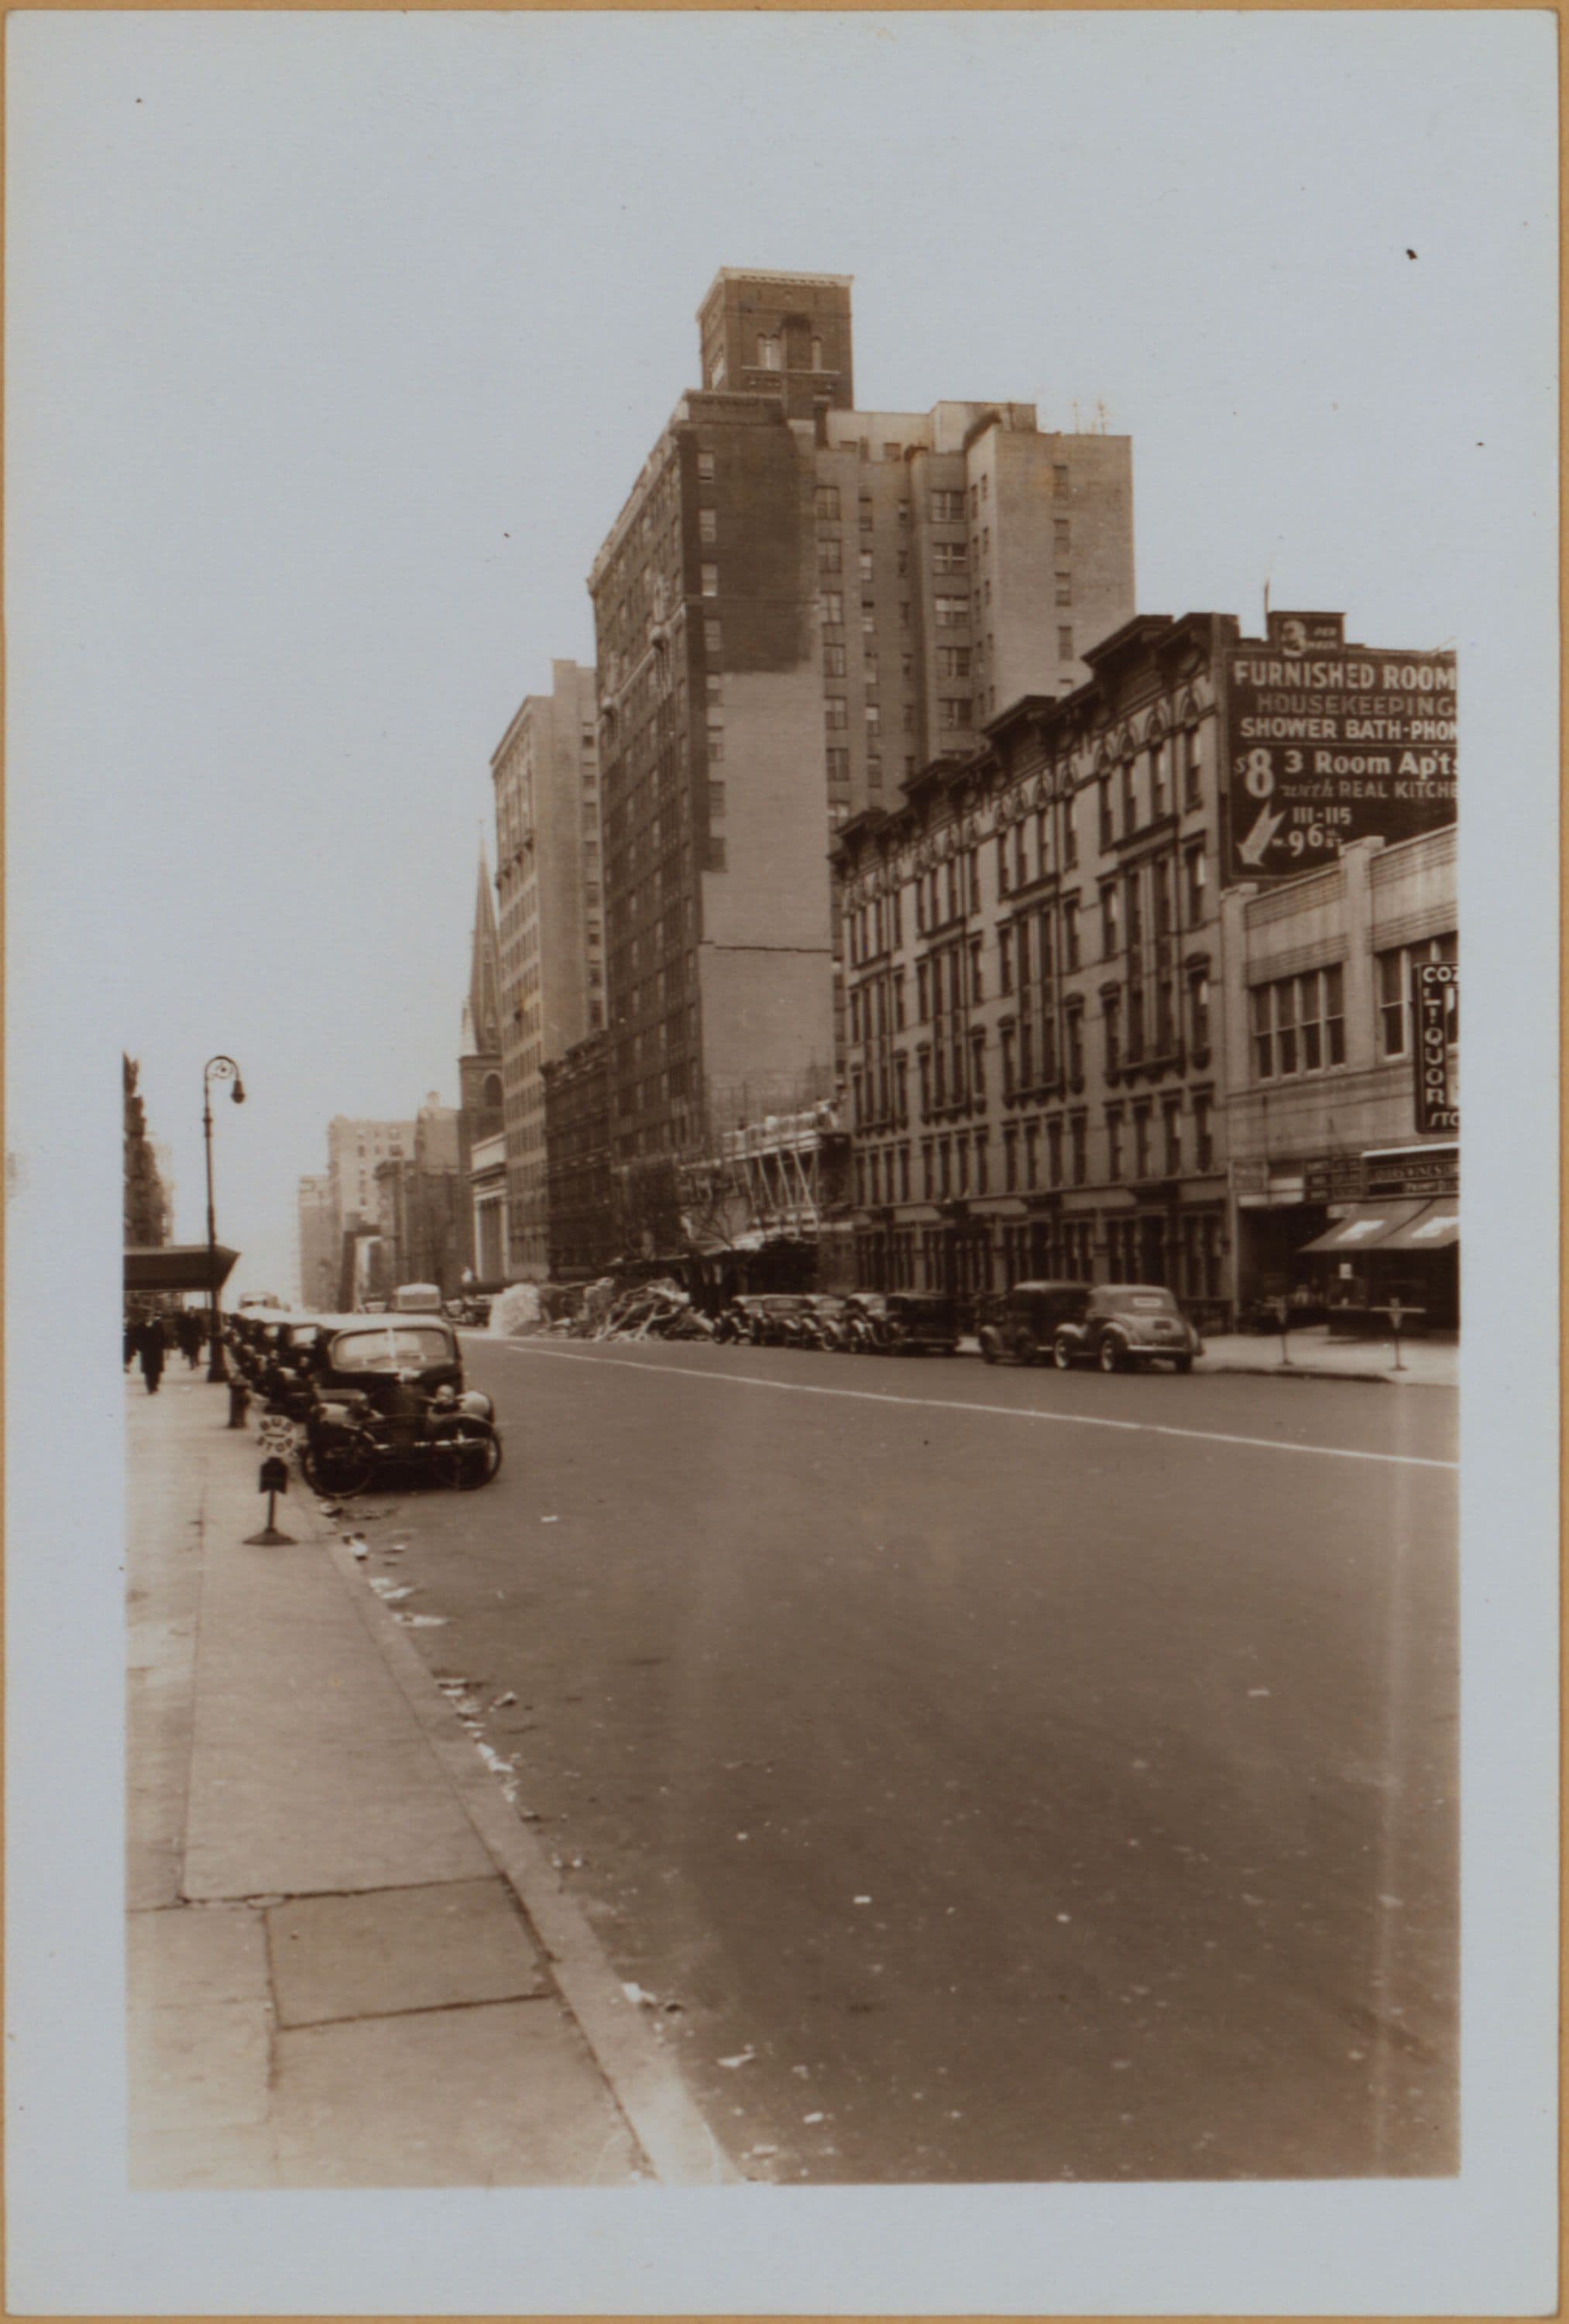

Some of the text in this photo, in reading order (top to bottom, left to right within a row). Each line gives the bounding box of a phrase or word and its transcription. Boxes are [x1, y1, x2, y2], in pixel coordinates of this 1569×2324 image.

[1234, 660, 1457, 691] FURNISHED ROOM
[1257, 693, 1454, 717] HOUSEKEEPING
[1241, 716, 1338, 739] SHOWER
[1284, 749, 1303, 774] 3
[1315, 750, 1391, 775] Room
[1280, 778, 1334, 798] with
[1338, 780, 1389, 798] REAL
[1423, 987, 1445, 1104] LIQUOR
[259, 1416, 294, 1433] BUS
[256, 1437, 294, 1453] STOP
